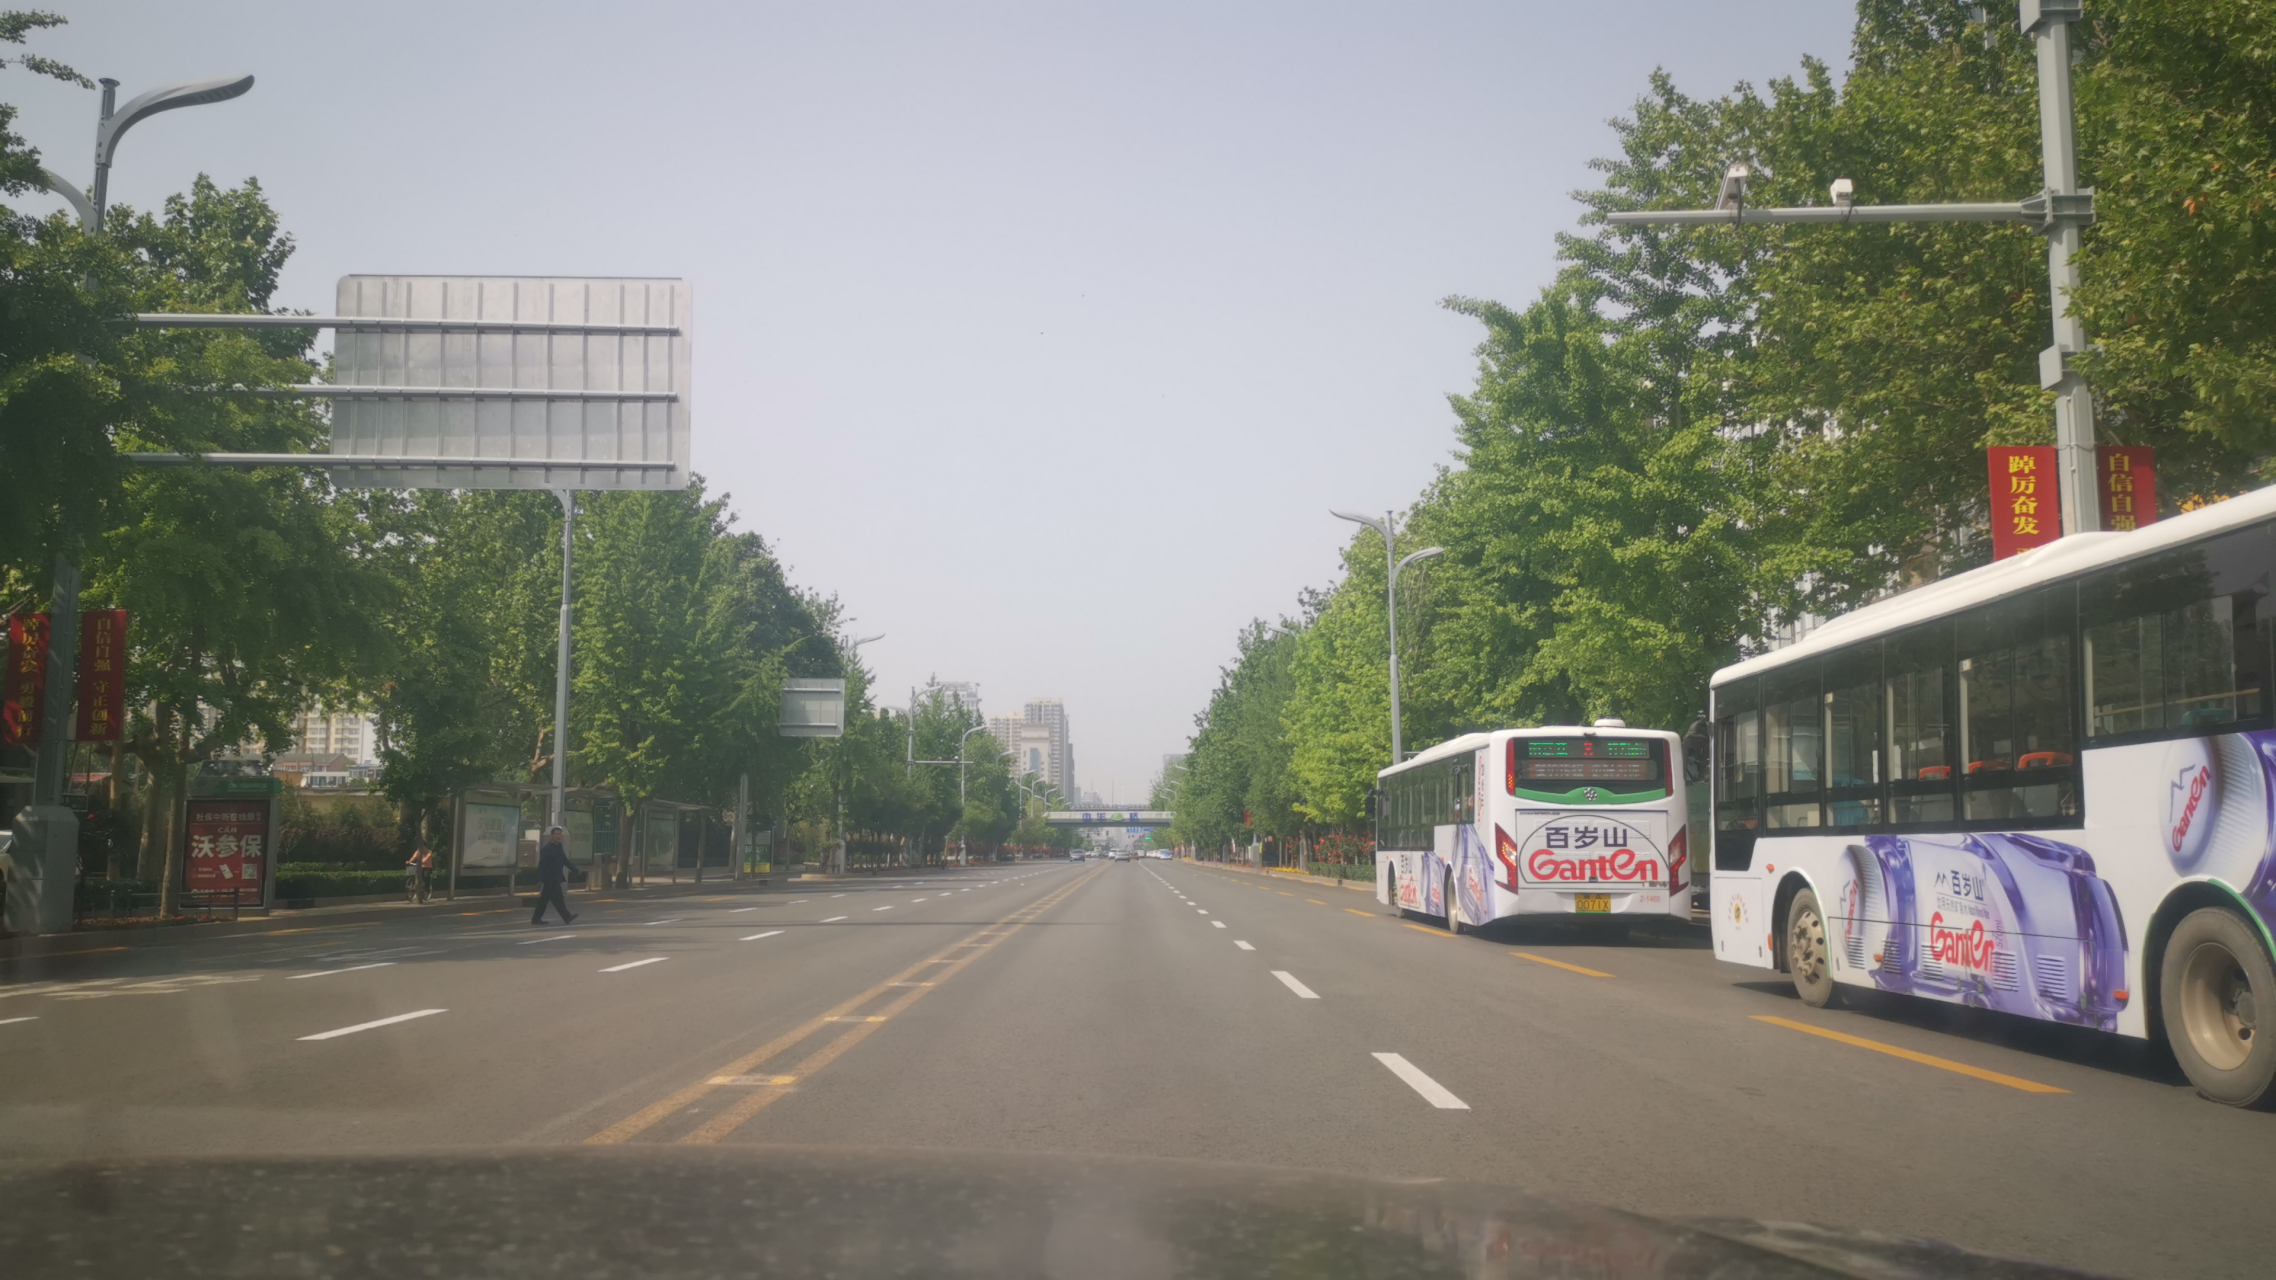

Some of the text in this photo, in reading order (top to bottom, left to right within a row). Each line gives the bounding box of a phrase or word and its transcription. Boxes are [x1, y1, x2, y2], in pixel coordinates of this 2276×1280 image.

[2008, 455, 2040, 536] 踔厉奋发
[2107, 453, 2137, 532] 自信自强
[89, 618, 111, 736] 自信自强 守正创新
[190, 834, 263, 859] 沃参保
[1545, 826, 1628, 849] 百岁山
[1950, 870, 1985, 902] 百岁山
